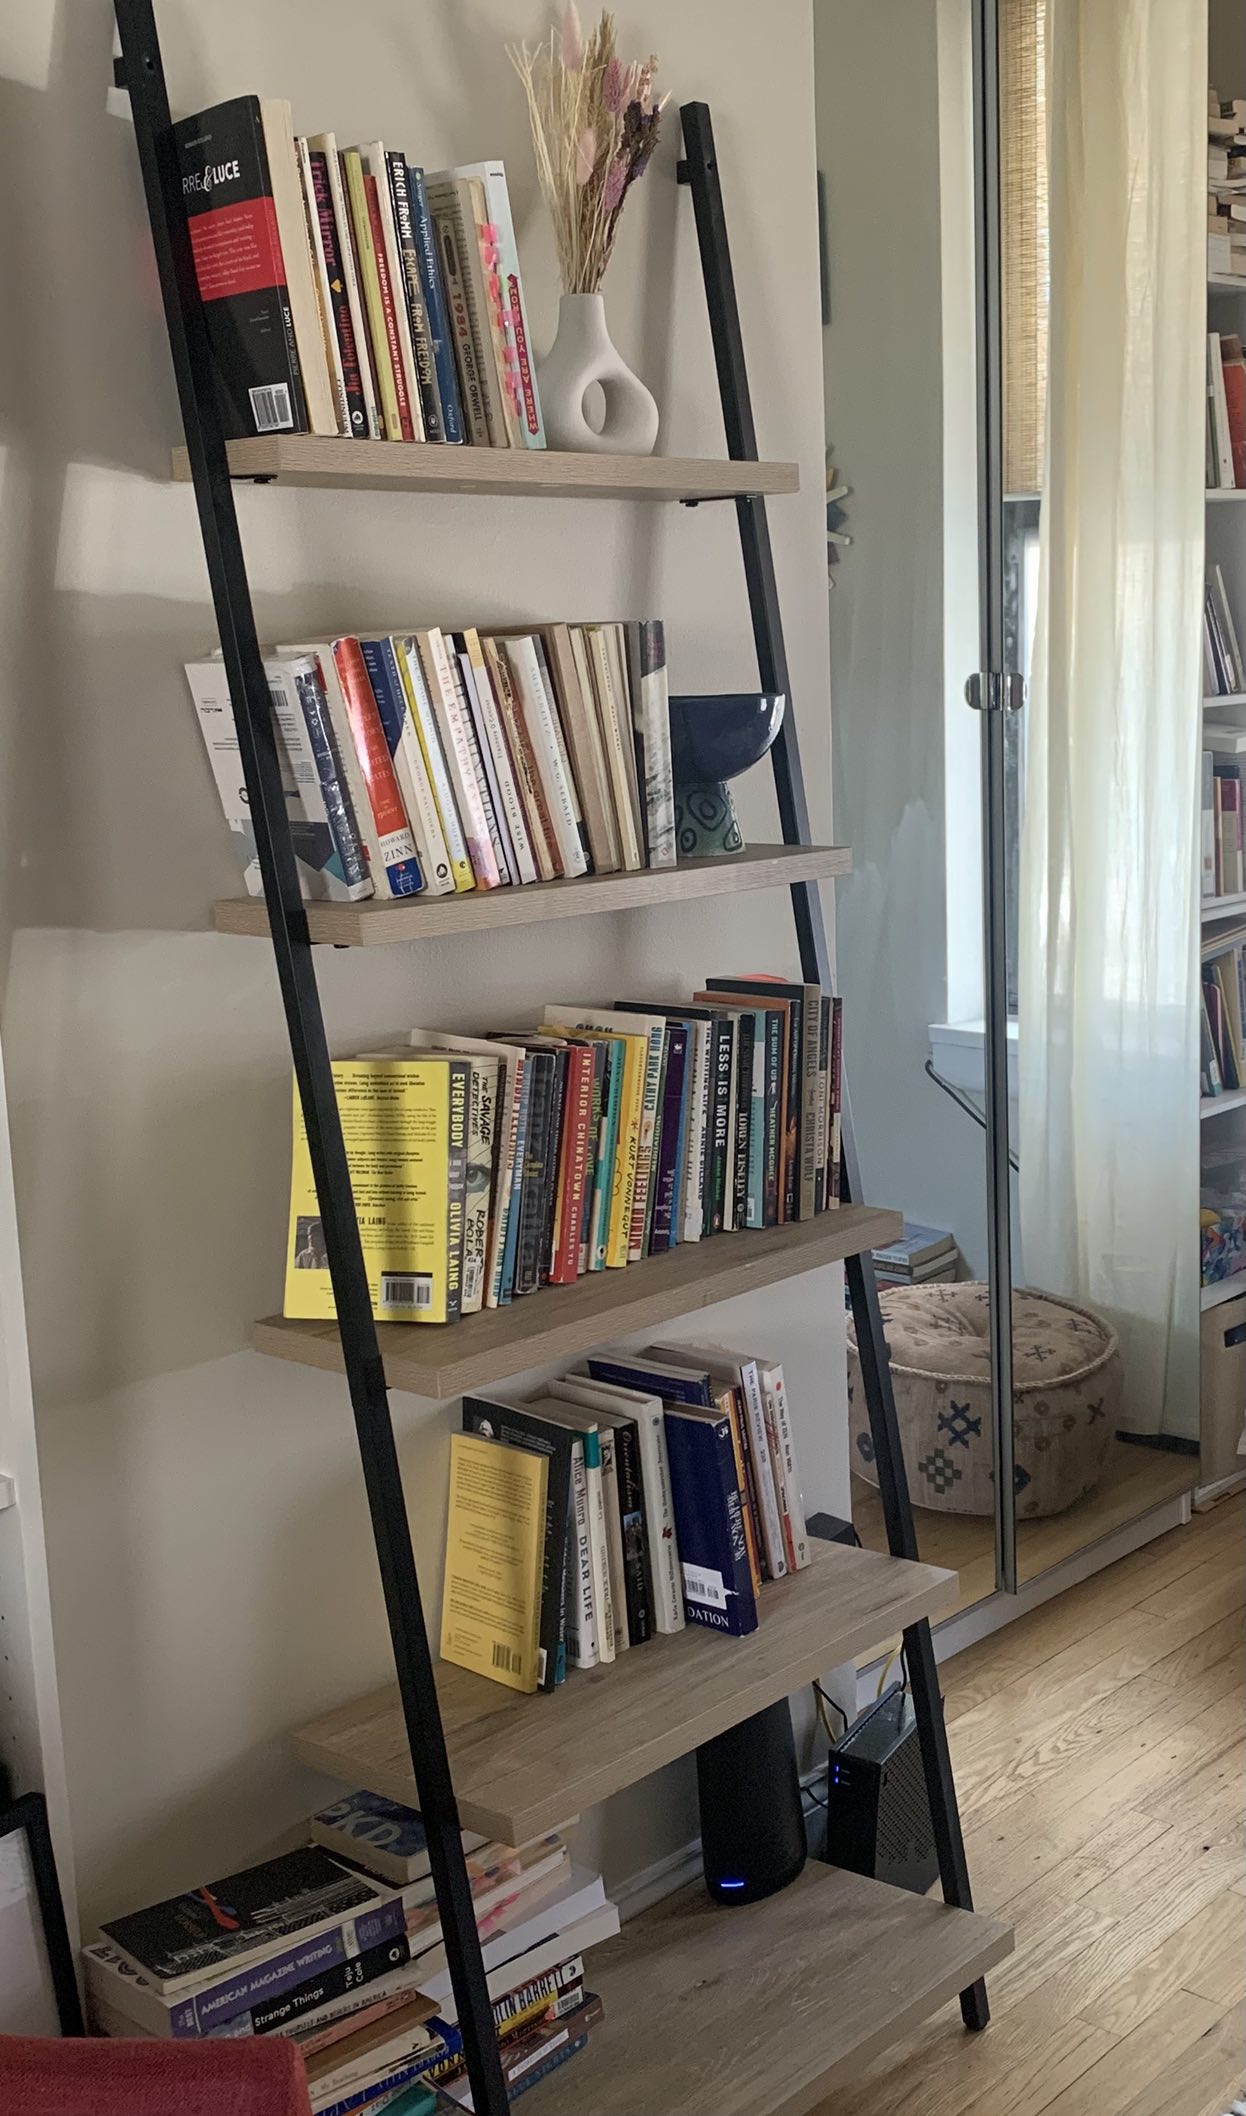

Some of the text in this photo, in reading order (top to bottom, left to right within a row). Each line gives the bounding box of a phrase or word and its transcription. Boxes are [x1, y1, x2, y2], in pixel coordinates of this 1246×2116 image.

[311, 161, 328, 202] Trick
[392, 161, 413, 239] ERICH FROMM
[318, 208, 337, 266] Mirror
[420, 215, 433, 256] Applied
[377, 253, 388, 291] FREEDOM
[426, 258, 435, 289] Ethics
[282, 306, 291, 327] LUCE
[384, 291, 391, 301] IS
[452, 293, 468, 337] 1984
[387, 316, 398, 362] CONSTANT
[515, 327, 526, 353] YOU
[394, 364, 406, 407] STRUGGLE
[462, 343, 483, 421] GEORGE ORWELL
[520, 358, 530, 383] ARE
[447, 404, 457, 434] Oxford
[524, 389, 539, 431] WHERE
[504, 780, 517, 819] BLOOD
[380, 832, 411, 848] HOWARD
[384, 843, 414, 862] ZINN
[649, 1026, 663, 1052] HONG
[770, 1019, 779, 1081] THE SUM OF US
[807, 1000, 819, 1078] CITY OF ANGELS
[646, 1055, 660, 1079] PARK
[451, 1072, 466, 1150] EVERYBODY
[470, 1070, 480, 1137] DETECTIVES
[592, 1077, 603, 1122] WORKS
[644, 1081, 657, 1111] CATHY
[715, 1035, 730, 1148] LESS IS MORE
[480, 1094, 493, 1147] SAVAGE
[572, 1053, 591, 1200] INTERIOR CHINATOWN
[817, 1105, 825, 1165] MORRISON
[513, 1140, 525, 1191] EVERYMAN
[736, 1111, 749, 1199] LOREN EISELEY
[804, 1113, 815, 1182] CHRISTA WOLF
[621, 1135, 637, 1239] KURT VONNEGUT
[634, 1146, 652, 1203] FEELINGS
[448, 1202, 464, 1291] OLIVIA LAING
[464, 1218, 475, 1259] BOLA
[475, 1209, 486, 1262] ROBER
[567, 1206, 578, 1265] CHARLES YU
[747, 1370, 764, 1442] THE PARIS REVIEW
[622, 1430, 637, 1509] Orientalism
[573, 1456, 593, 1622] Alice Munro DEAR LIFE
[558, 1618, 566, 1643] Water
[687, 1606, 729, 1627] DATION
[200, 1944, 333, 2015] AMERICAN MAGAZINE WRITING
[343, 1966, 353, 1990] Teju
[355, 1961, 363, 1984] Cole
[254, 2004, 291, 2027] Strange
[292, 1986, 325, 2010] Things
